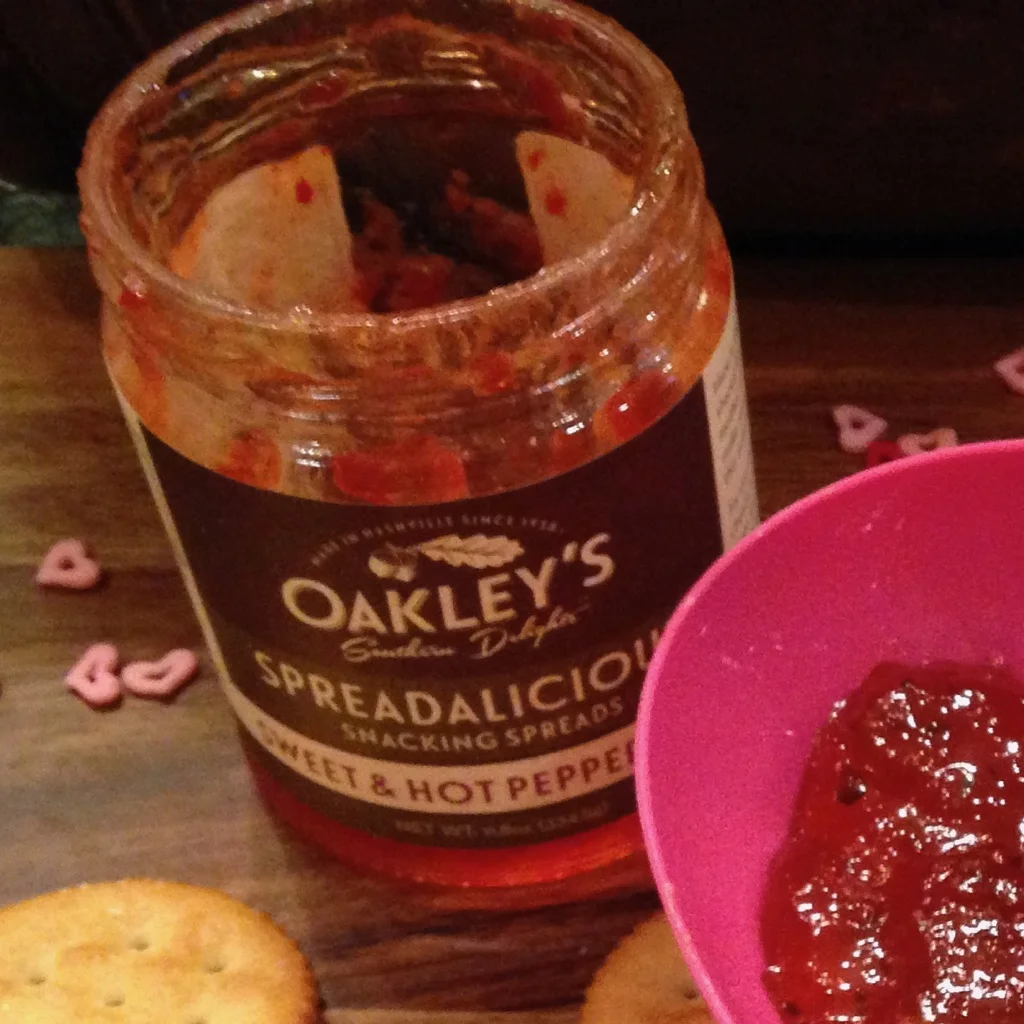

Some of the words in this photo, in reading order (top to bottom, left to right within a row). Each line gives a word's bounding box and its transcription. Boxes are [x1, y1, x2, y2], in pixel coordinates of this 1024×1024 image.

[461, 514, 513, 527] SINCE
[281, 532, 615, 634] OAKLEY'S
[341, 721, 498, 755] SNACKING
[505, 695, 624, 748] SPREADS
[255, 719, 358, 790] SWEET
[371, 774, 394, 798] &
[408, 778, 495, 804] HOT
